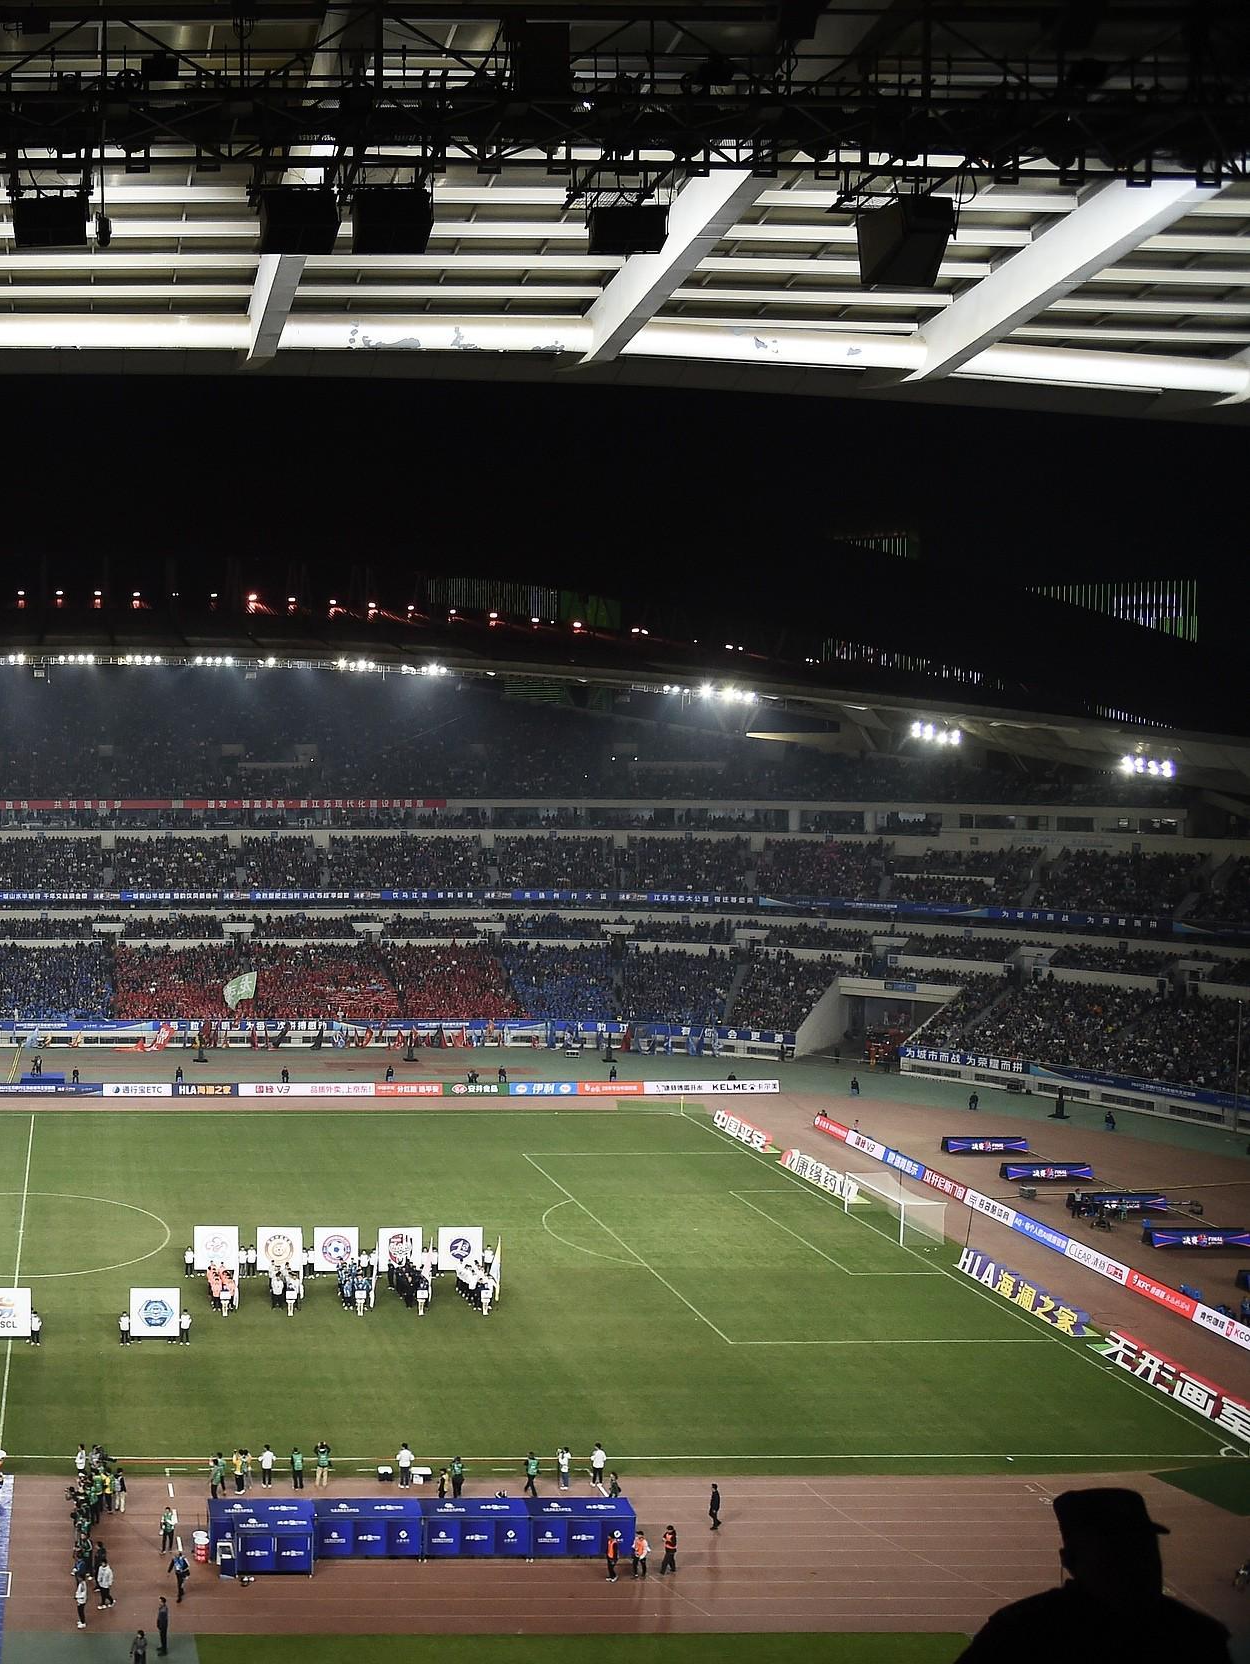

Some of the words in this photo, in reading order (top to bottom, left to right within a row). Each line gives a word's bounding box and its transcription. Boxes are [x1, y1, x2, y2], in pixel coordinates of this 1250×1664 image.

[1002, 911, 1069, 922] 为城市而战
[905, 1048, 961, 1065] 为城市而战
[966, 1054, 1023, 1073] 为荣耀而拼
[122, 1085, 163, 1094] 通行宝ETC
[276, 1085, 291, 1094] V3
[467, 1084, 498, 1093] 安井食品
[532, 1083, 555, 1094] 伊利
[712, 1083, 748, 1091] KELME
[712, 1109, 768, 1152] 中国平安
[1182, 1236, 1198, 1246] 决赛
[1068, 1243, 1091, 1265] CLEAR
[1136, 1279, 1151, 1291] KFC
[959, 1248, 1079, 1337] HLA海澜之家
[1103, 1329, 1250, 1444] 无形画室
